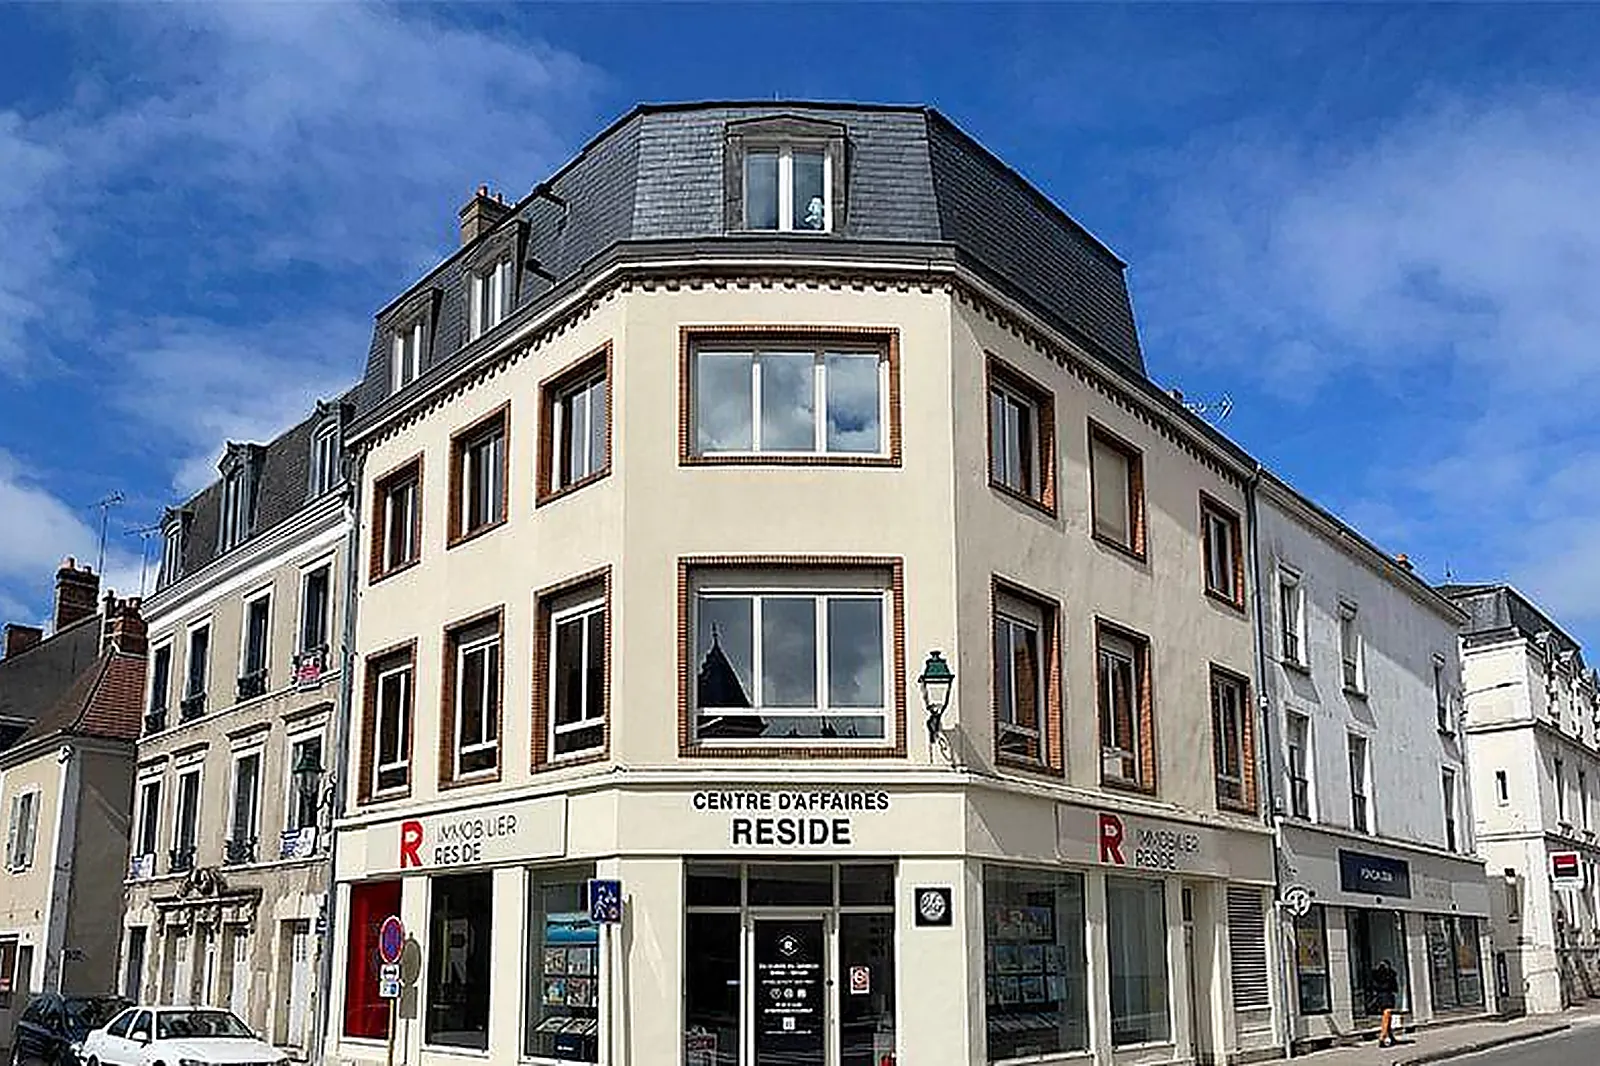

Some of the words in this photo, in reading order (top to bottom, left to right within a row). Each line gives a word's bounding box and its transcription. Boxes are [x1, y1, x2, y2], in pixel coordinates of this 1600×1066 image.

[693, 792, 772, 810] CENTRE
[778, 792, 889, 810] D'AFFAIRES
[436, 814, 517, 842] IMMOBLIER
[732, 818, 851, 845] RESIDE
[1099, 813, 1125, 865] R
[400, 820, 423, 868] R
[434, 842, 482, 865] RESDE
[1136, 829, 1200, 853] IMMOBLIER
[1135, 848, 1176, 871] RESDE
